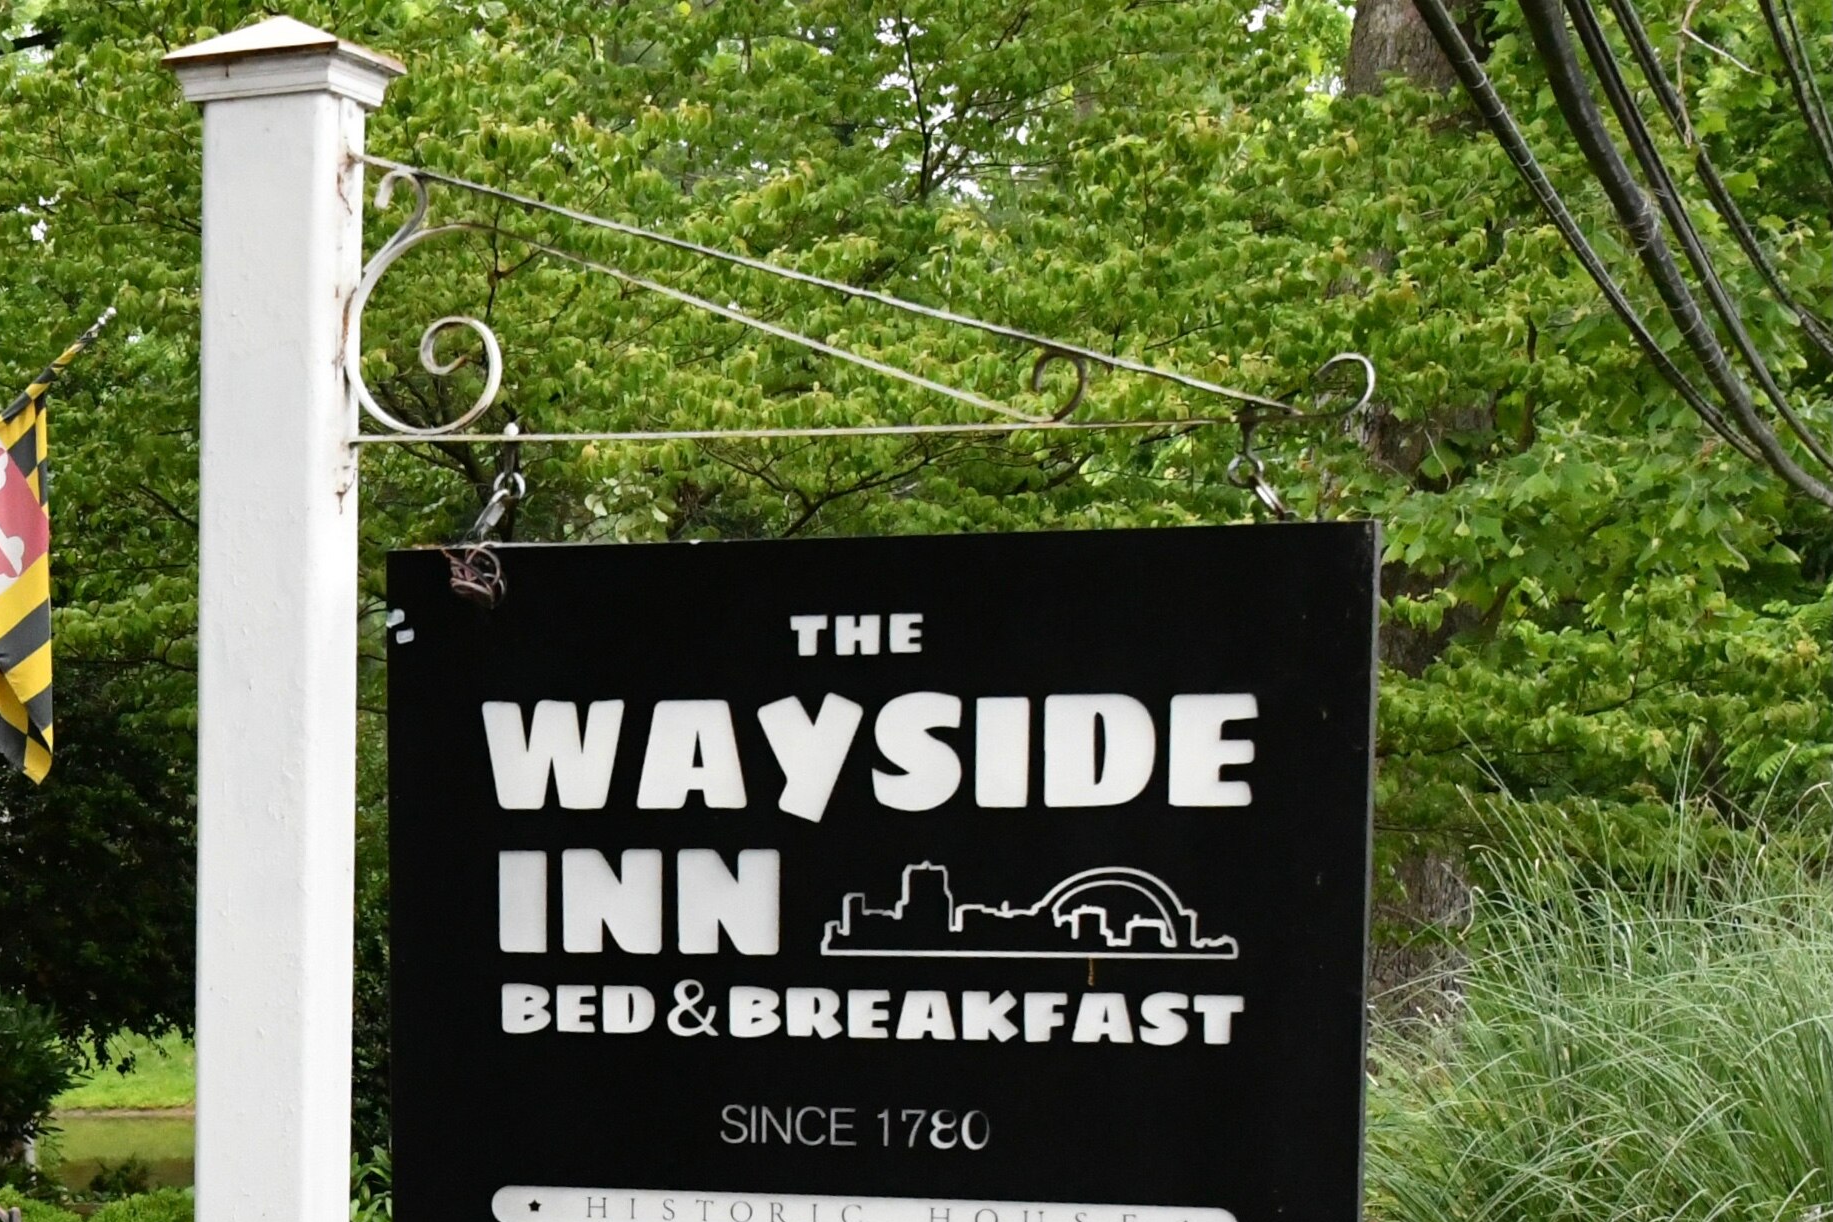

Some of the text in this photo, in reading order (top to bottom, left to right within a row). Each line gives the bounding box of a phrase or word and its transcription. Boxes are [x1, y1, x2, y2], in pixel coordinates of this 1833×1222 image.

[789, 612, 924, 657] THE
[481, 692, 1259, 823] WAYSIDE
[498, 849, 781, 956] INN
[720, 1104, 990, 1151] SINCE 1780
